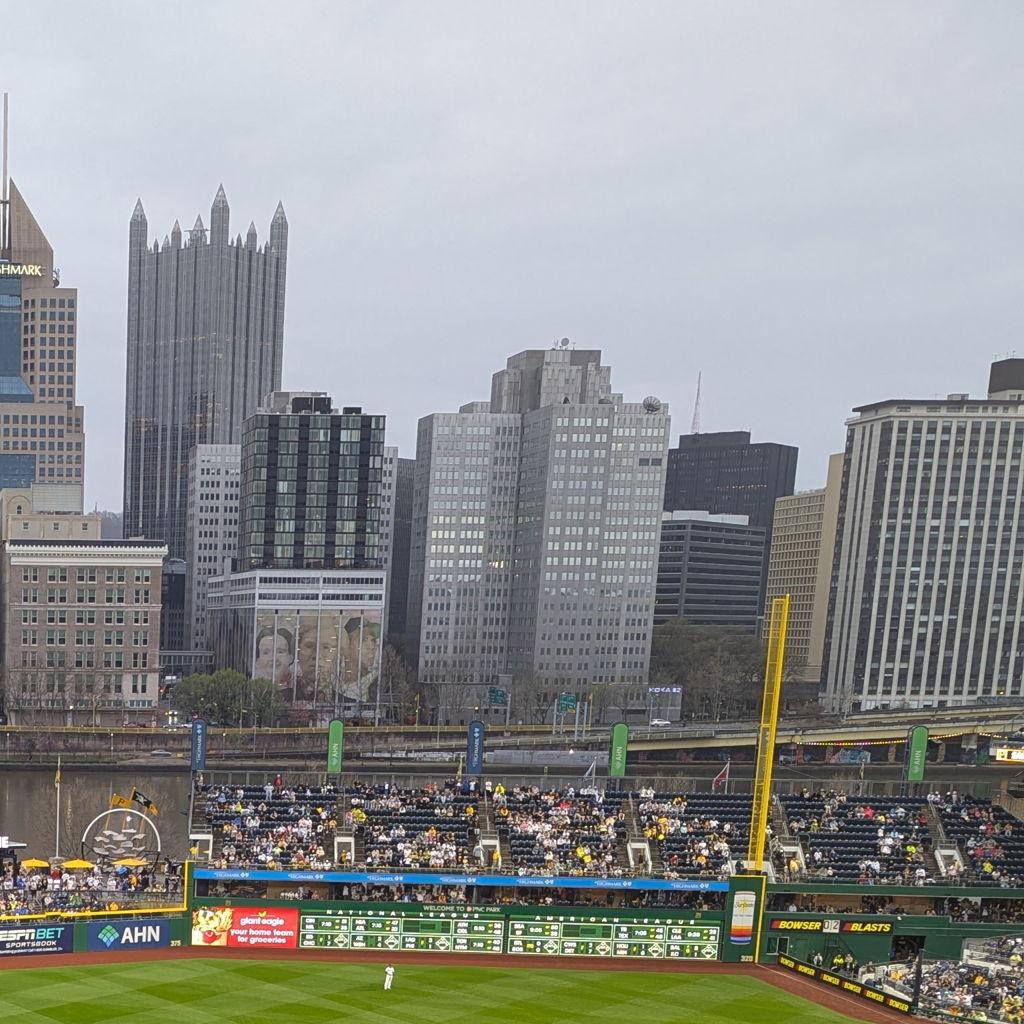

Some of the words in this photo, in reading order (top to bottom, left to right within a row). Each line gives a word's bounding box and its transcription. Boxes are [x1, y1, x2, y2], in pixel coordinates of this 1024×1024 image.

[615, 746, 623, 761] AHN
[239, 917, 261, 927] giant
[260, 918, 285, 927] eagle
[778, 920, 822, 930] BOWSER
[850, 923, 892, 932] BLASTS
[36, 927, 64, 940] BET
[120, 926, 160, 944] AHN
[230, 929, 248, 938] your
[249, 928, 272, 936] home
[272, 929, 294, 937] team
[5, 940, 57, 948] SPORTSBOOK
[237, 935, 249, 943] for
[249, 936, 287, 944] groceries
[780, 956, 795, 968] BOWSER
[798, 963, 816, 976] BOWSER
[822, 973, 840, 985] BOWSER
[843, 981, 862, 994] BOWSER
[865, 990, 884, 1002] BOWSER
[888, 999, 909, 1012] BOWSER
